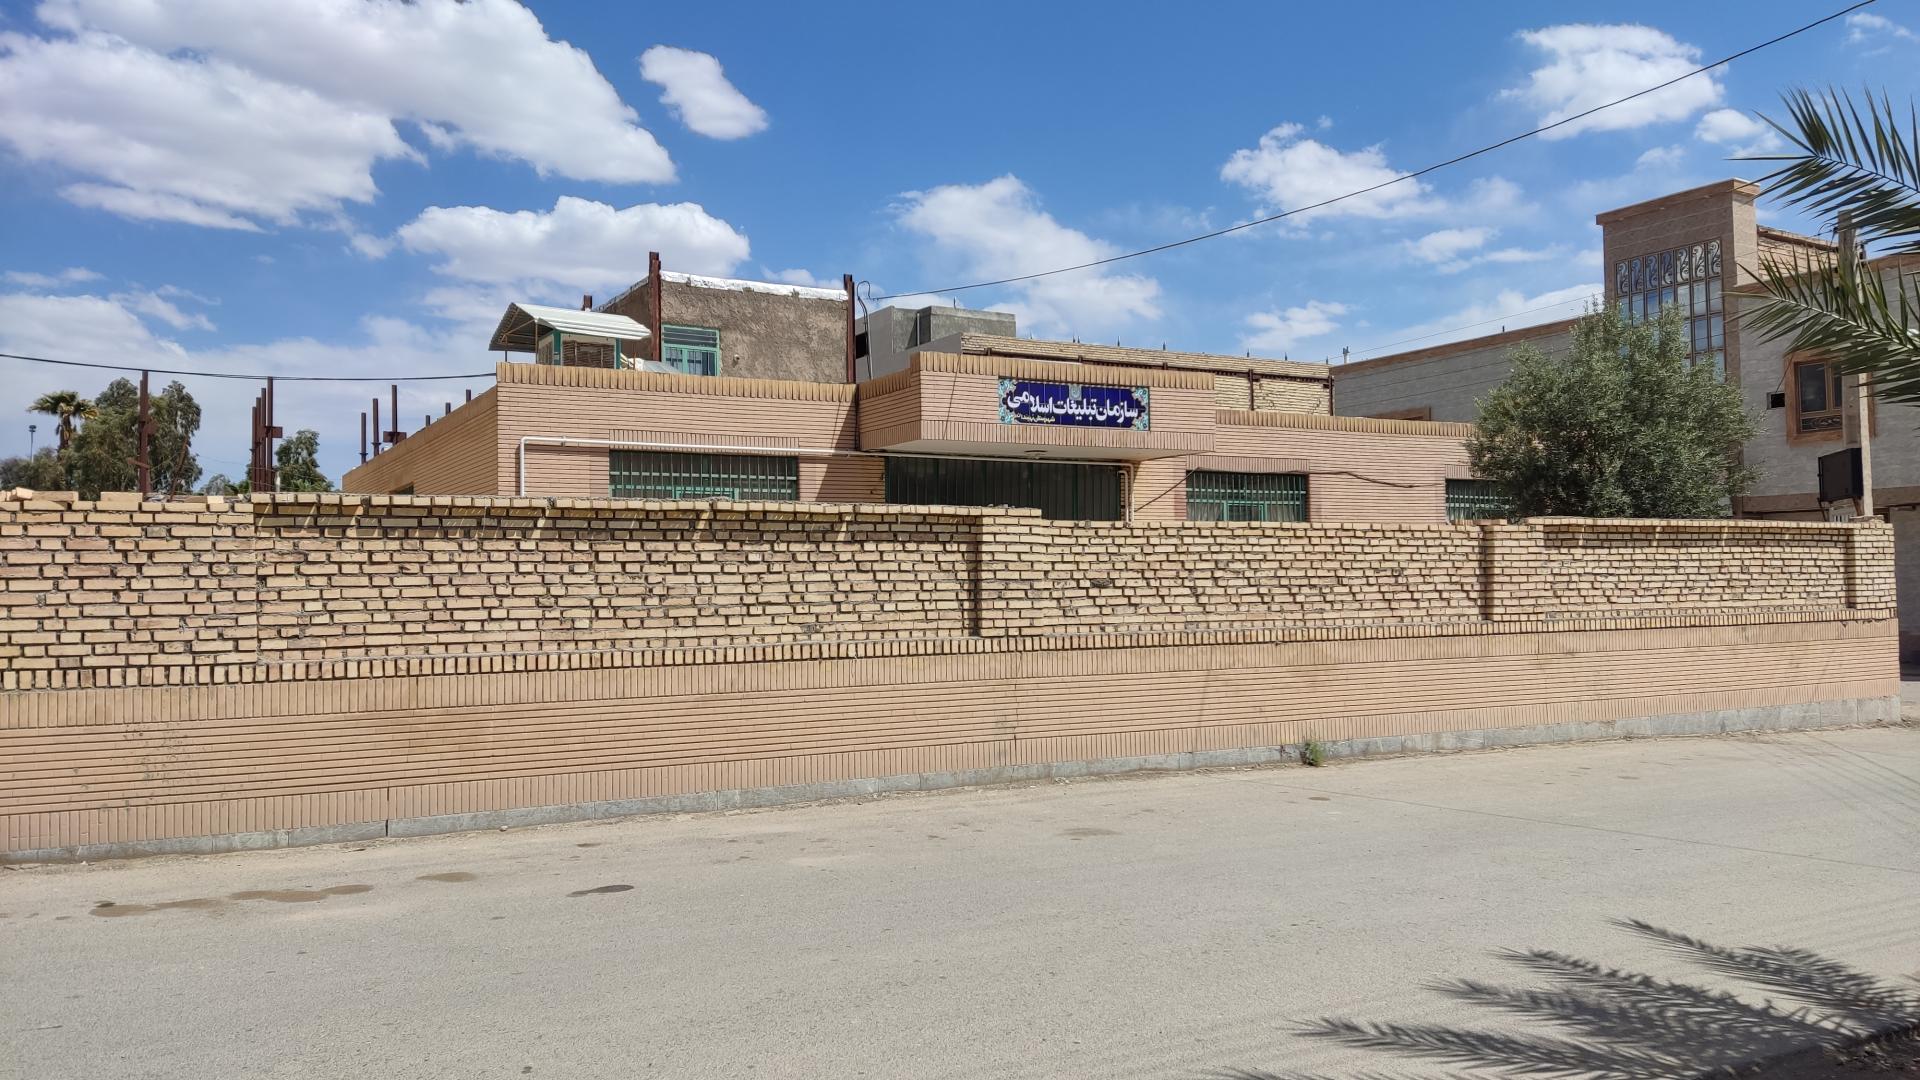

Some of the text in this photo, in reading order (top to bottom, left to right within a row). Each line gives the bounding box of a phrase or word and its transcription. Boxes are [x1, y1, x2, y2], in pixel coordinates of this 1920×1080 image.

[1007, 391, 1138, 423] سازمان تبلیغات اسلامی
